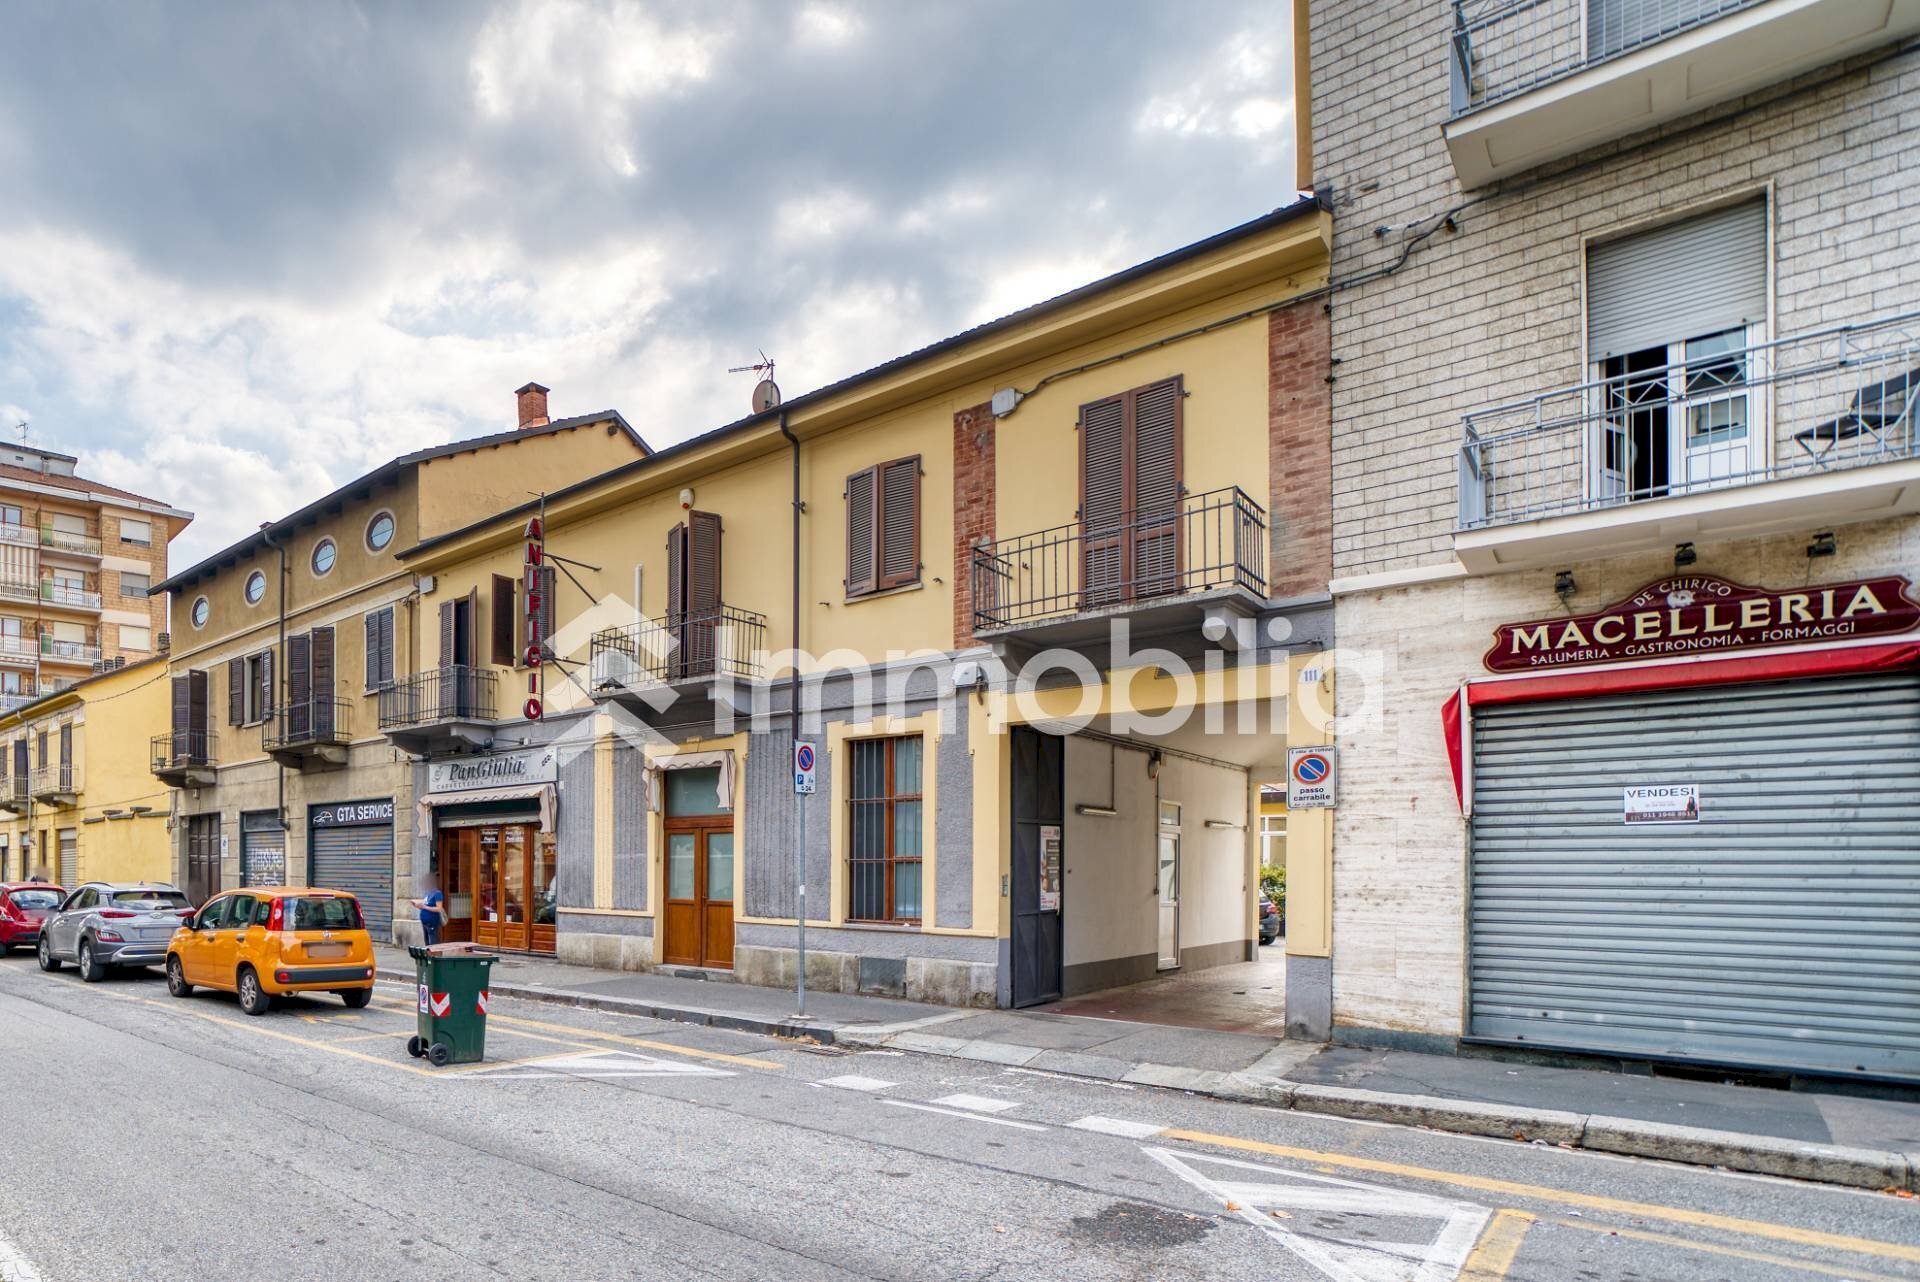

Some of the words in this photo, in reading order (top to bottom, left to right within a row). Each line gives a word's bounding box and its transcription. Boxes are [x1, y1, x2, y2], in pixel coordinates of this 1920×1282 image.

[1633, 591, 1655, 607] DE
[1658, 578, 1732, 597] CHIRICO
[523, 518, 542, 720] ANIFICIO
[1510, 584, 1888, 654] MACELLERIA
[1530, 647, 1610, 666] SALUMERIA
[1625, 633, 1744, 656] GASTRONOMIA
[1761, 622, 1856, 641] FORMAGGI
[1304, 669, 1318, 682] 111
[449, 756, 523, 781] PanGiulia
[1294, 794, 1331, 802] carrabile
[1627, 788, 1694, 798] VENDESI
[337, 806, 356, 822] GTA
[357, 804, 392, 821] SERVICE
